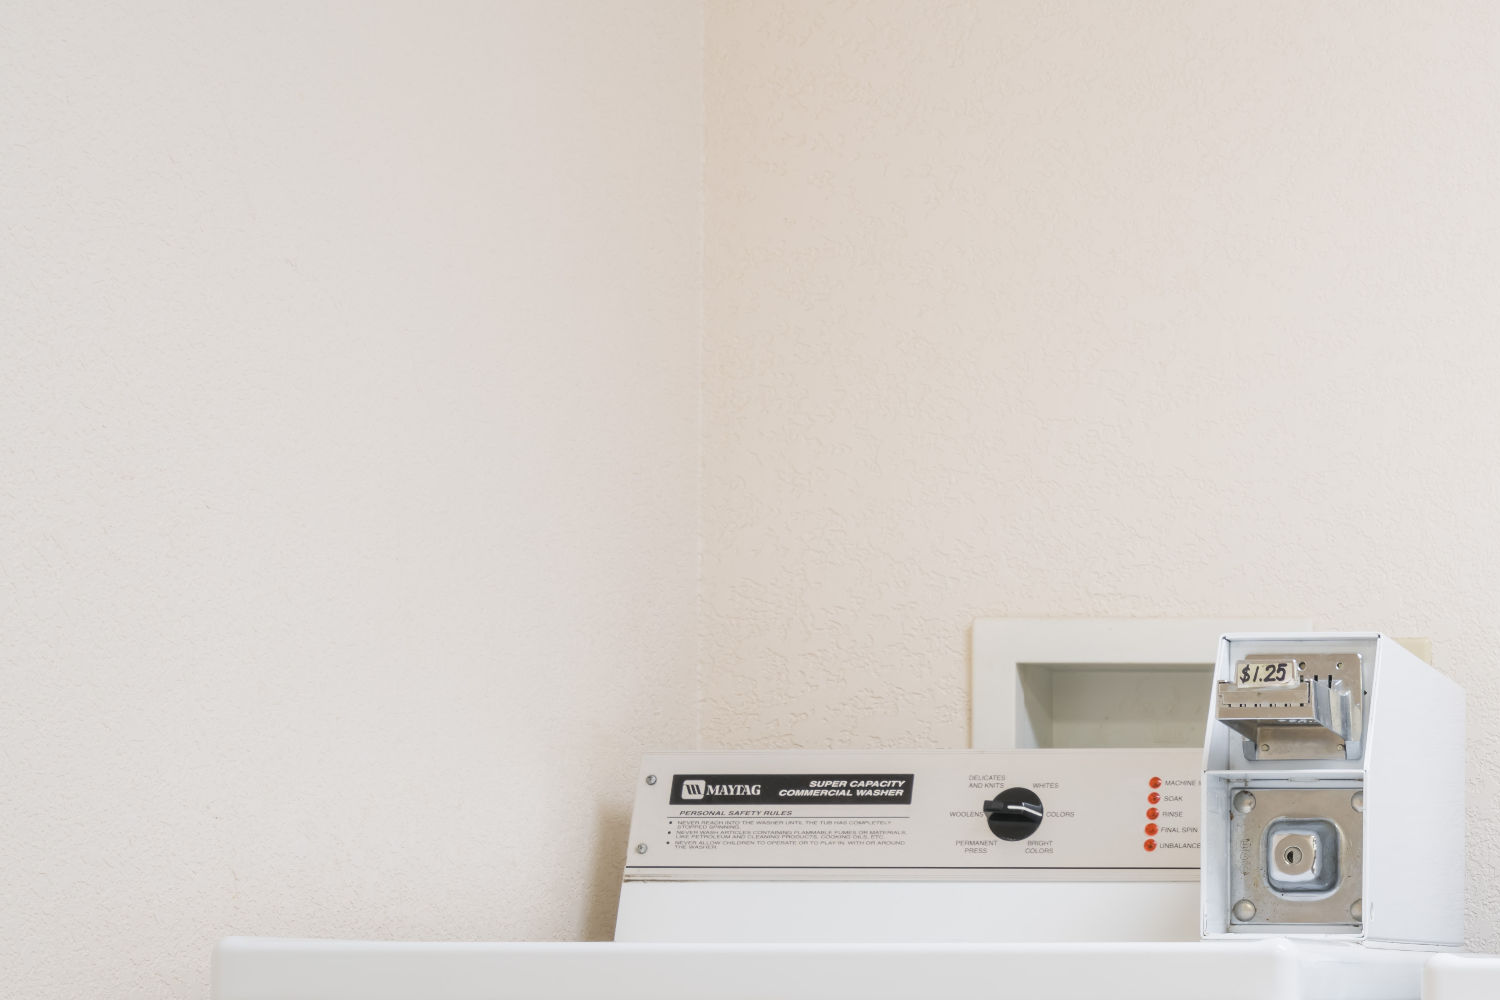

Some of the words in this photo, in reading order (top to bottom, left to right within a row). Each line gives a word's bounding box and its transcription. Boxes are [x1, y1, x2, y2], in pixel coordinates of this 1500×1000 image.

[1239, 663, 1288, 684] $1.25
[809, 780, 848, 788] SUPER
[849, 780, 906, 788] CAPACITY
[706, 784, 762, 796] MAYTAG
[778, 789, 853, 797] COMMERCIAL
[856, 789, 905, 797] WASHER
